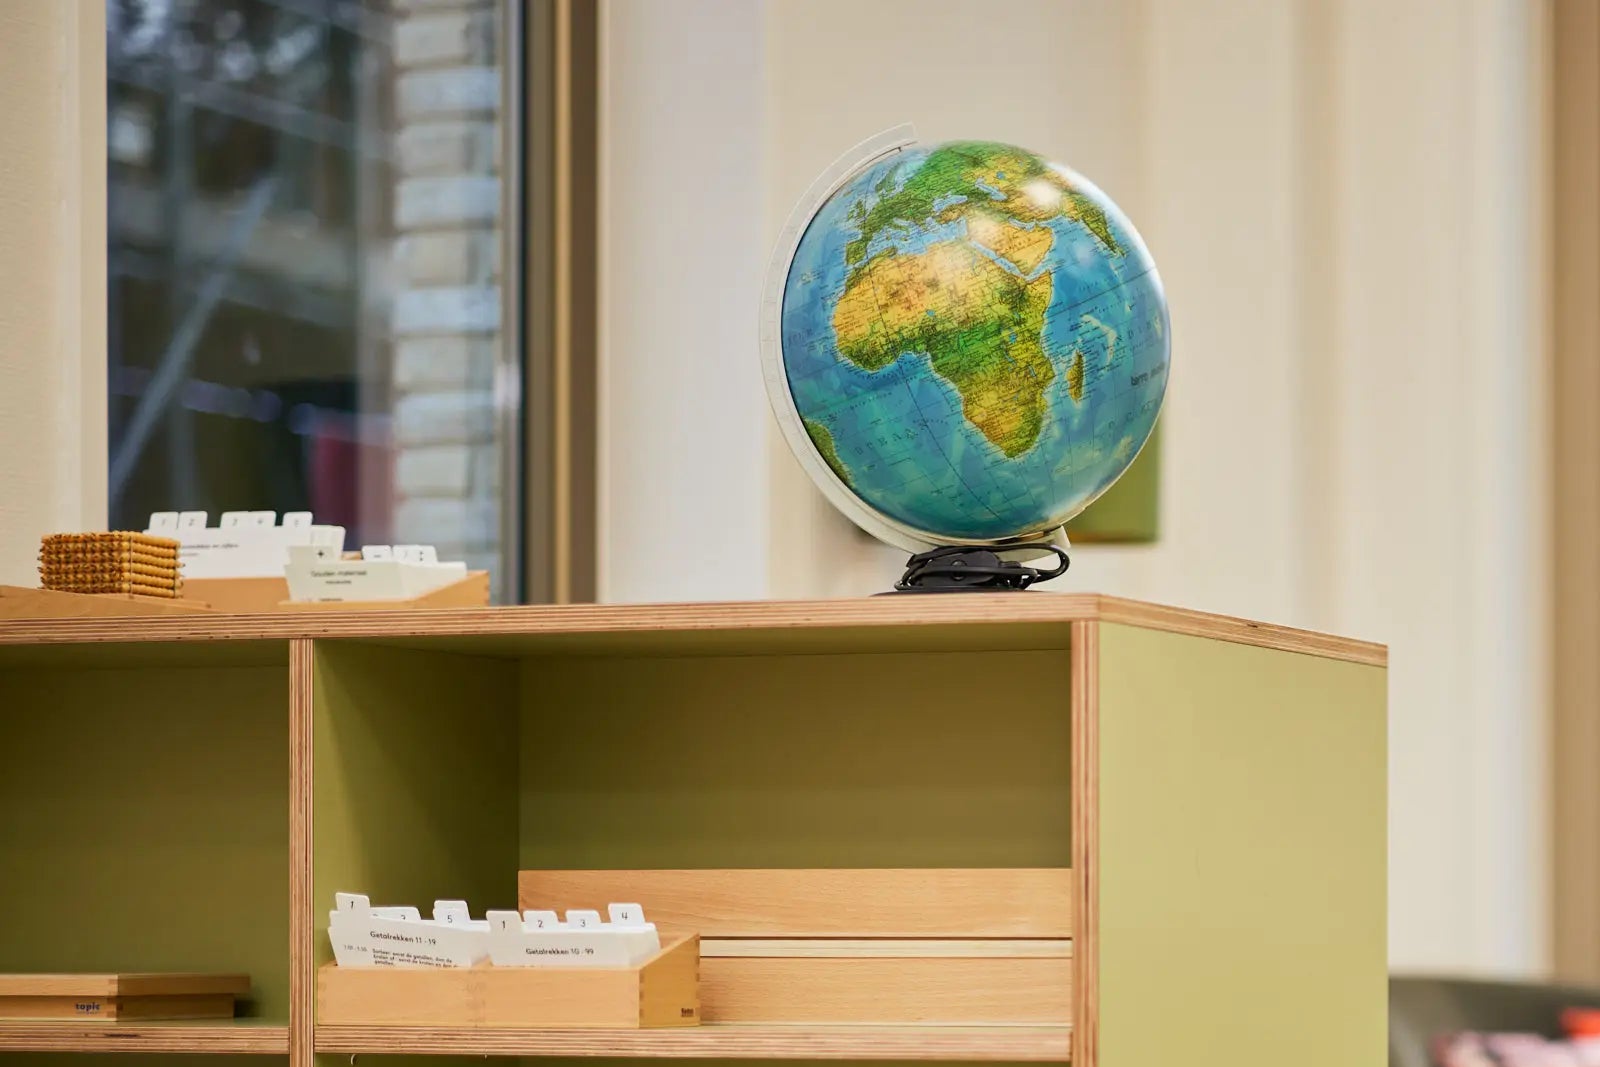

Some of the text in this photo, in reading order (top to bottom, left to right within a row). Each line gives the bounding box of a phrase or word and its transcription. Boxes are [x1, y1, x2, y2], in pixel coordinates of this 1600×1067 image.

[350, 900, 355, 910] 1
[447, 914, 453, 924] 5
[620, 911, 628, 921] 4
[501, 919, 506, 929] 1
[537, 919, 544, 929] 2
[580, 919, 587, 928] 3
[370, 930, 414, 943] Getalrekken
[75, 1001, 100, 1012] topic
